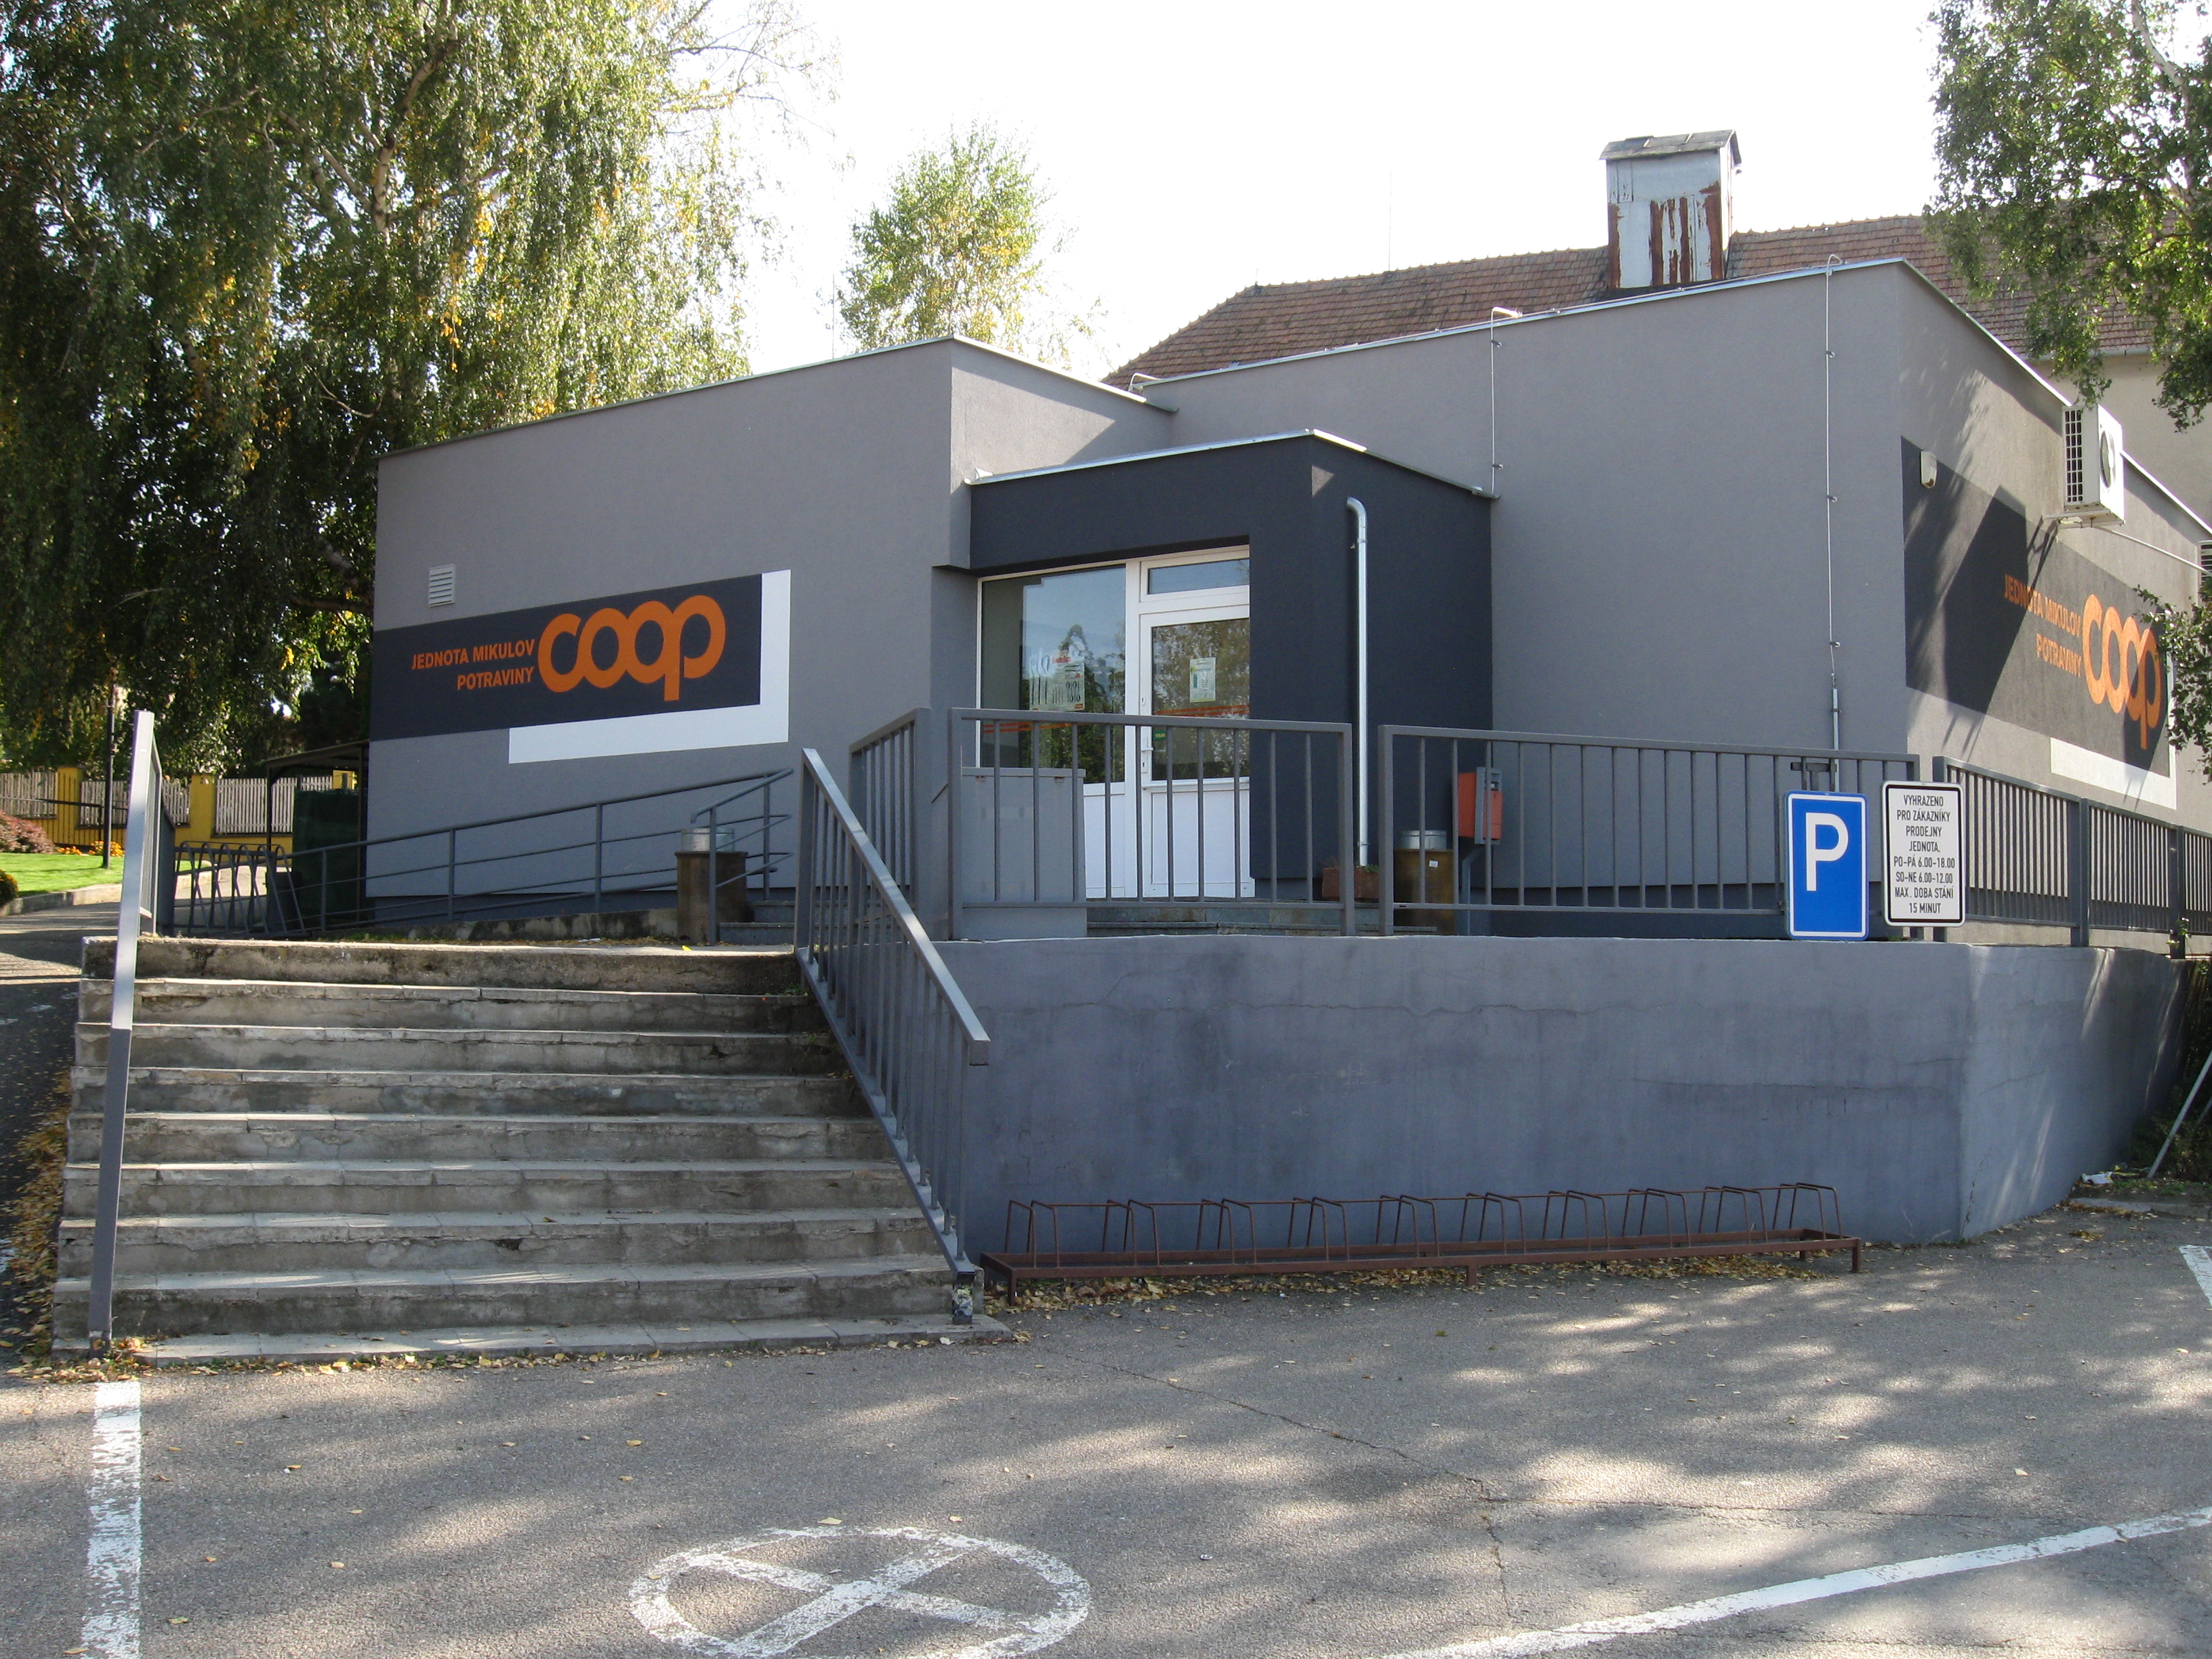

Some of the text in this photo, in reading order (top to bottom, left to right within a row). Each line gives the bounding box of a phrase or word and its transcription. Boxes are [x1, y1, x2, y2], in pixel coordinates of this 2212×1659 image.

[2005, 574, 2082, 637] JEDNOTA MIKULOV
[411, 638, 535, 670] JEDNOTA MIKULOV
[2036, 632, 2082, 678] POTRAVINY
[457, 666, 535, 691] POTRAVINY
[1903, 794, 1944, 806] VYHRAZENO
[1897, 808, 1951, 822] PRO ZÁKAZNÍKY
[1906, 825, 1942, 838] PRODEJNY
[1805, 812, 1849, 892] P
[1893, 854, 1955, 868] PO-PÁ 6.00-18.00
[1896, 872, 1953, 884] SO-NE 6.00-12.00
[1895, 885, 1954, 899] MAX. DOBA STÁNÍ
[1909, 902, 1942, 914] 15 MINUT
